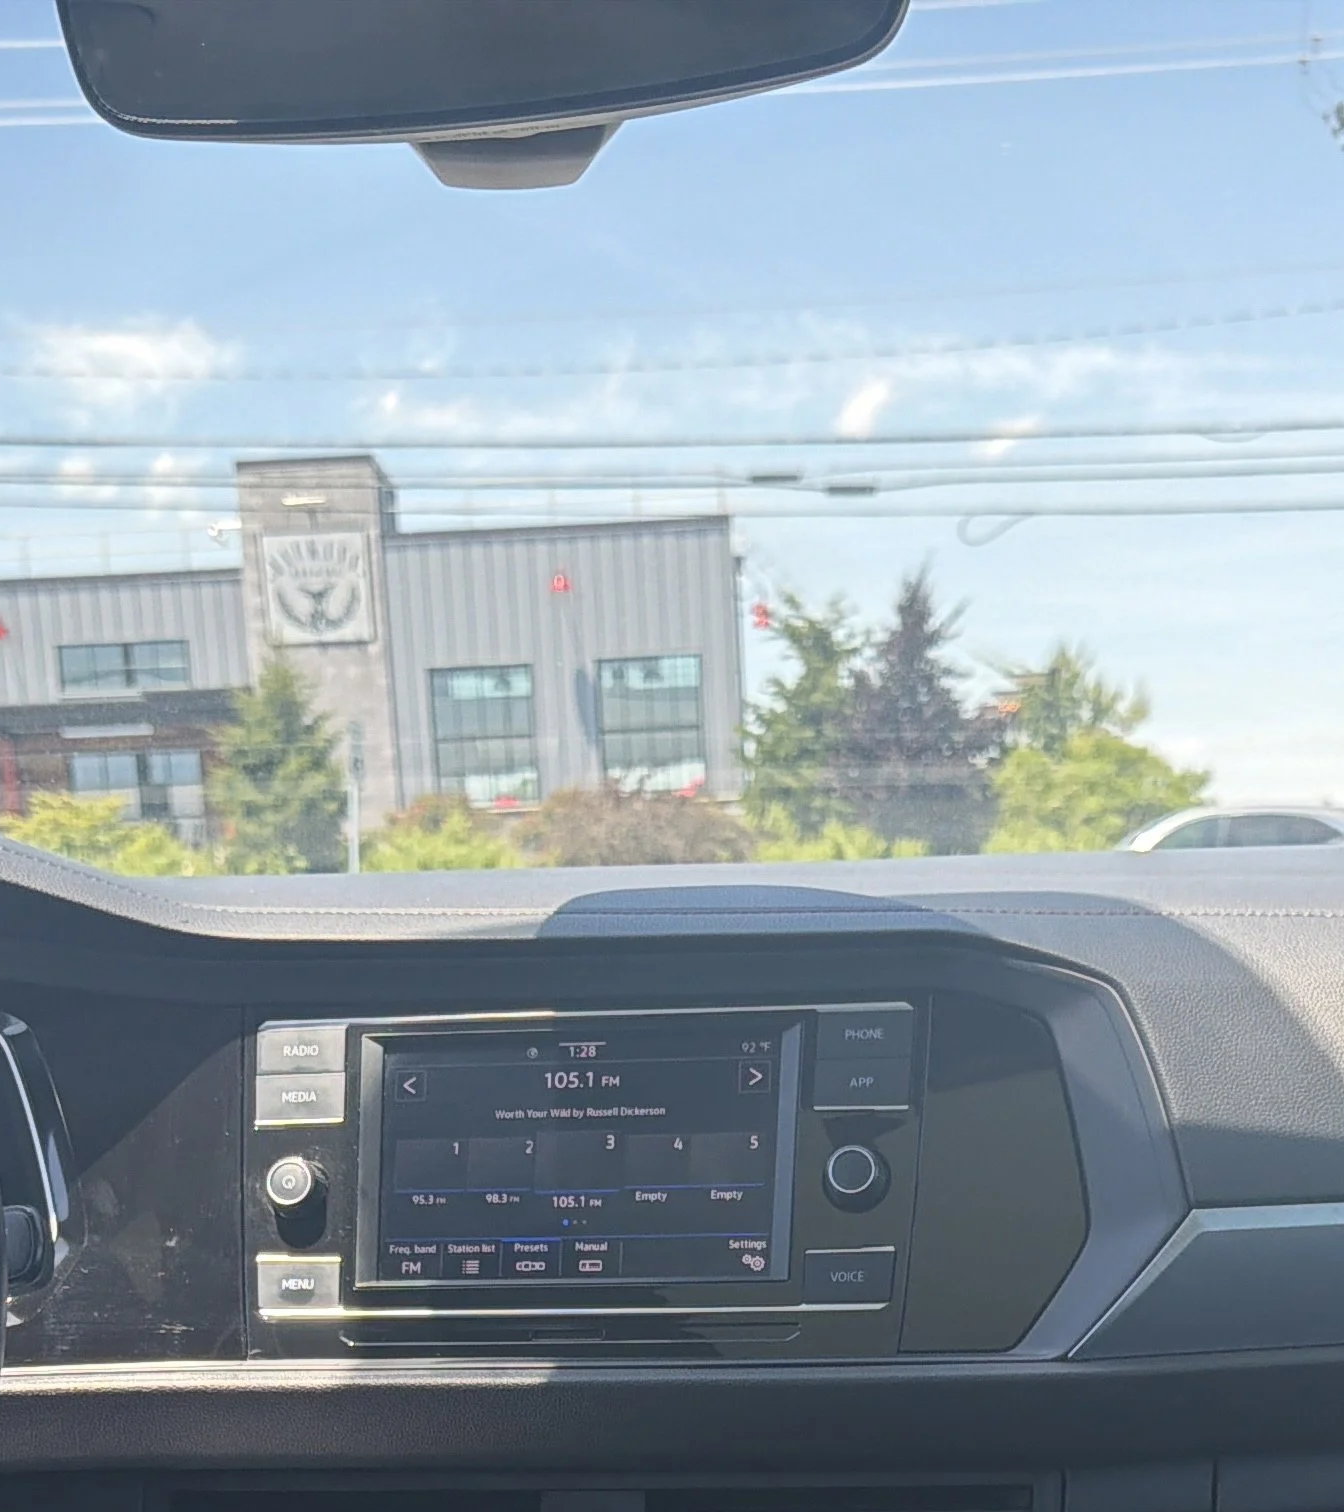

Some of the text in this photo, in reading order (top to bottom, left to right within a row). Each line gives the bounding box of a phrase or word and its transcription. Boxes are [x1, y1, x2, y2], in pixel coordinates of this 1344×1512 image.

[844, 1028, 884, 1041] PHONE
[283, 1044, 319, 1057] RADIO
[569, 1045, 596, 1058] 1:28
[741, 1041, 757, 1053] 92
[544, 1071, 620, 1089] 105.1 FM
[849, 1077, 874, 1088] APP
[281, 1091, 317, 1103] MEDIA
[494, 1106, 666, 1119] Worth Your Wild by Russell Dickerson
[525, 1140, 534, 1154] 2
[606, 1135, 615, 1150] 3
[673, 1137, 683, 1150] 4
[749, 1135, 759, 1149] 5
[452, 1142, 460, 1155] 1
[412, 1195, 434, 1205] 95.3
[485, 1194, 508, 1204] 98.3
[635, 1191, 668, 1203] Empty
[710, 1190, 743, 1201] Empty
[552, 1196, 602, 1208] 105.1 FM
[389, 1244, 437, 1255] Freq. band
[448, 1244, 495, 1253] Station list
[514, 1243, 549, 1252] Presets
[575, 1241, 608, 1251] Manual
[729, 1239, 767, 1250] Settings
[401, 1261, 422, 1274] FM
[830, 1271, 864, 1282] VOICE
[281, 1279, 315, 1290] MENU
